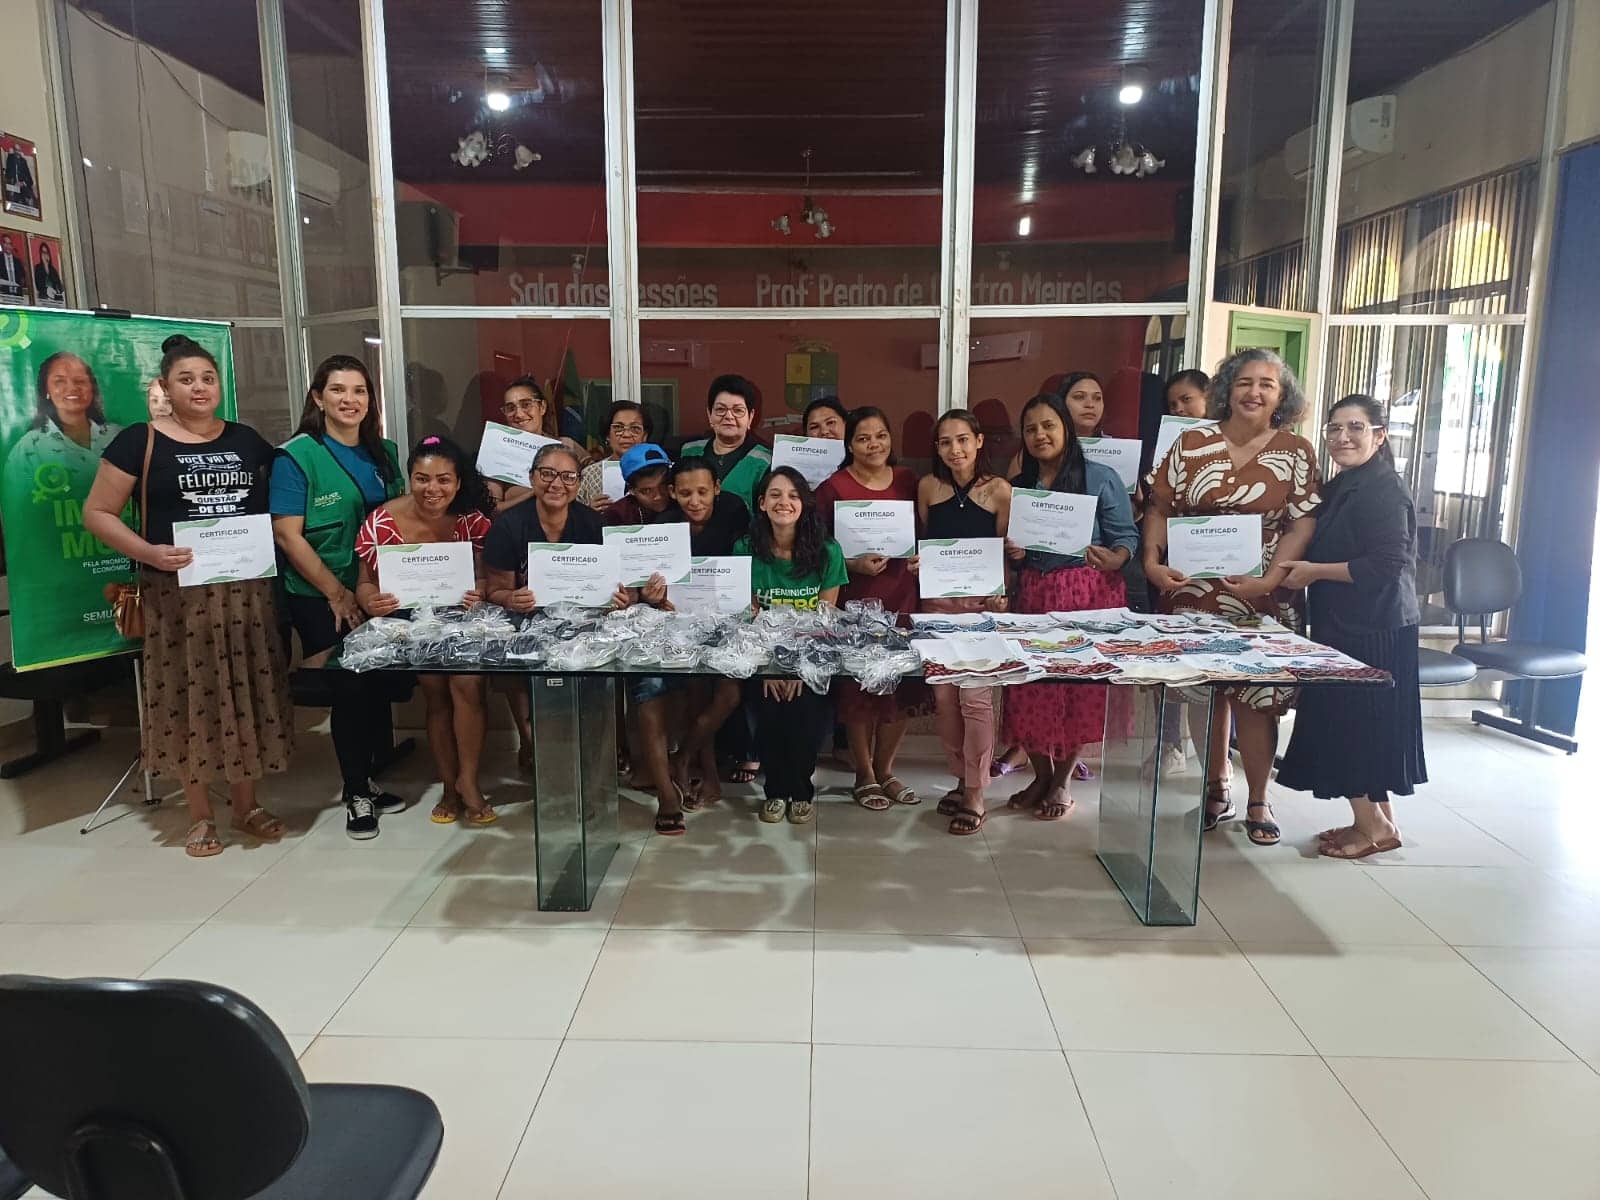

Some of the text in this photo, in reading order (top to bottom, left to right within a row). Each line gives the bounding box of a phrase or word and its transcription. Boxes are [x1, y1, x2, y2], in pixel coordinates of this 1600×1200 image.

[509, 272, 559, 306] Sala
[565, 272, 609, 306] dos
[638, 272, 719, 307] essões
[818, 273, 887, 306] Pedro
[894, 273, 922, 306] de
[1021, 271, 1122, 304] Meireles
[178, 471, 254, 490] FELICIDADE
[196, 495, 237, 503] QUESTÃO
[199, 504, 237, 514] DE SER
[1031, 501, 1074, 512] CERTIFICADO
[199, 528, 249, 539] CERTIFICADO
[1190, 527, 1238, 535] CERTIFICADO
[625, 535, 669, 544] CERTIFICADO
[939, 549, 983, 557] CERTIFICADO
[401, 555, 450, 564] CERTIFICADO
[551, 555, 598, 563] CERTIFICADO
